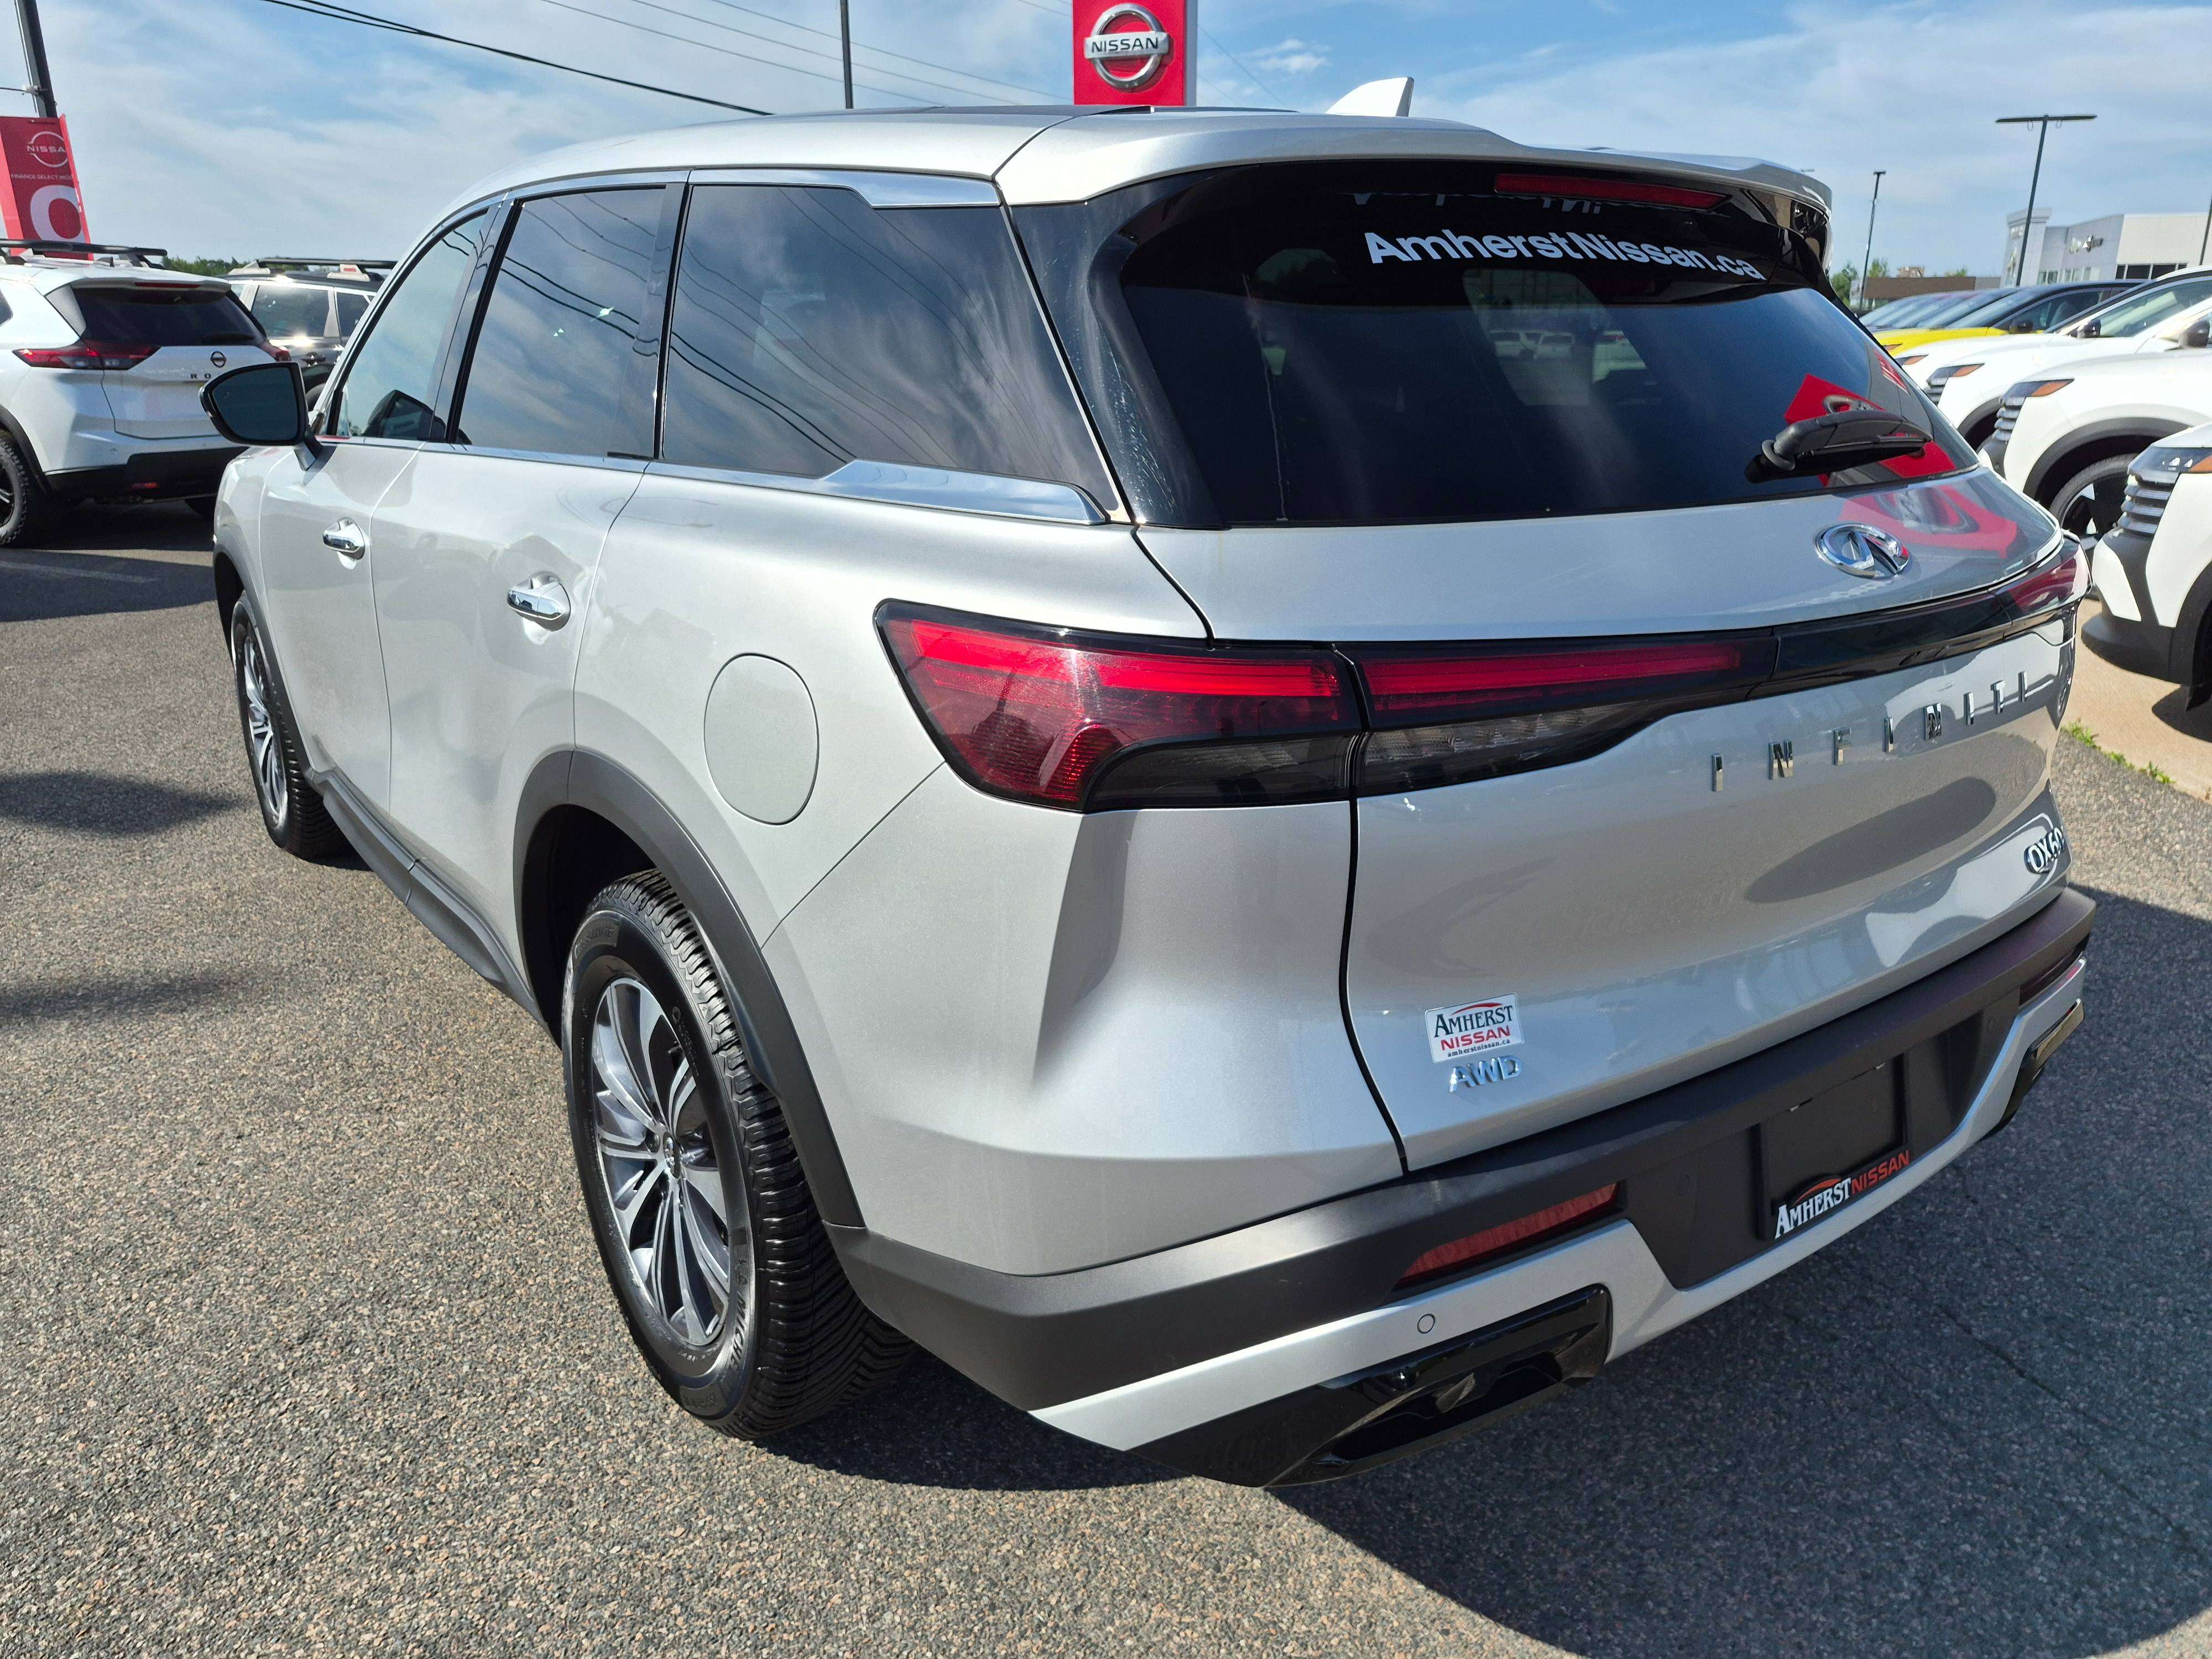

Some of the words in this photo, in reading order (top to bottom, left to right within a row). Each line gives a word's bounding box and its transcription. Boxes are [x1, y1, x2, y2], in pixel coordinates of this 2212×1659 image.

[1091, 37, 1159, 53] NISSAN
[27, 145, 66, 154] NISSA
[1364, 228, 1767, 280] AmherstNissan.ca
[1711, 671, 2027, 792] INFINITI
[1433, 1005, 1514, 1037] AMHERST
[1440, 1025, 1511, 1051] NISSAN
[1447, 1038, 1511, 1057] amherstnissan.ca
[1448, 1054, 1522, 1092] AWD
[1774, 1177, 1851, 1240] AMHERST
[1851, 1150, 1910, 1195] NISSAN
